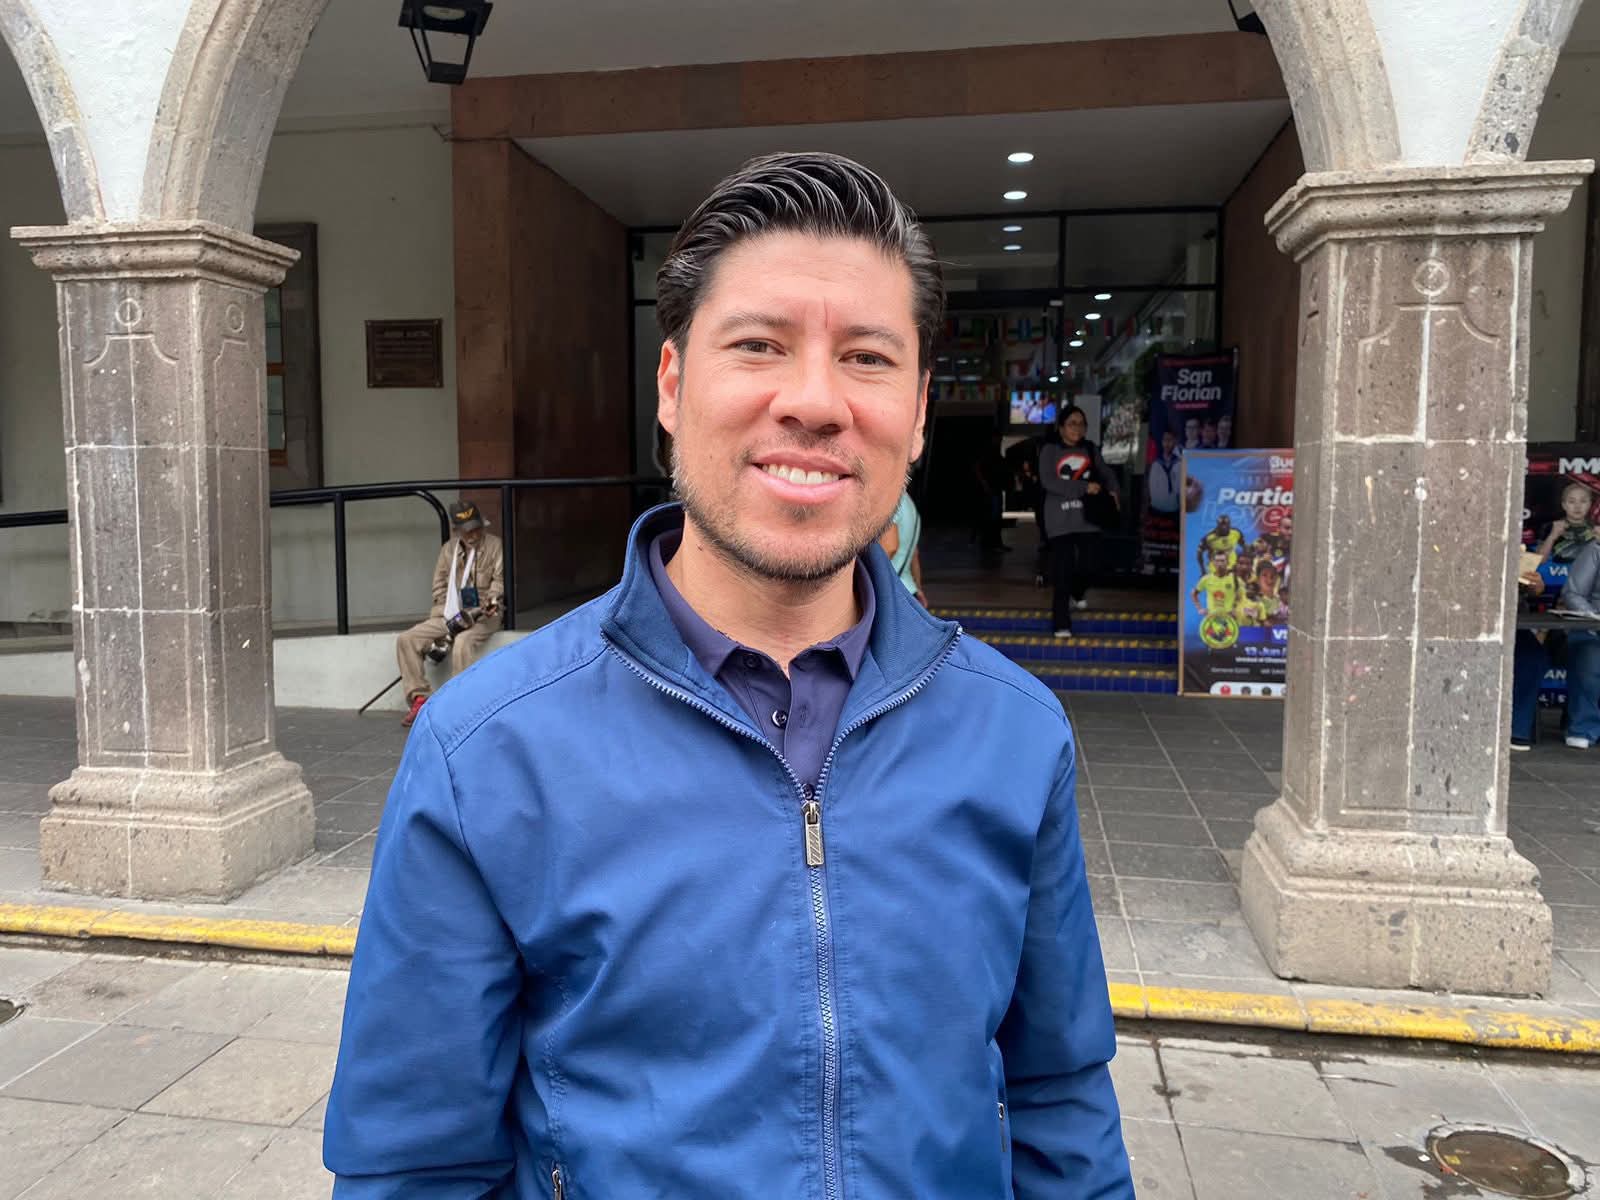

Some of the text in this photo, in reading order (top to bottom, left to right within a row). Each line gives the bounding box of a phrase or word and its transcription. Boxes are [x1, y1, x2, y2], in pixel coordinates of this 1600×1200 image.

[1177, 368, 1213, 385] San
[1160, 384, 1222, 401] Florian
[1559, 457, 1600, 474] MM
